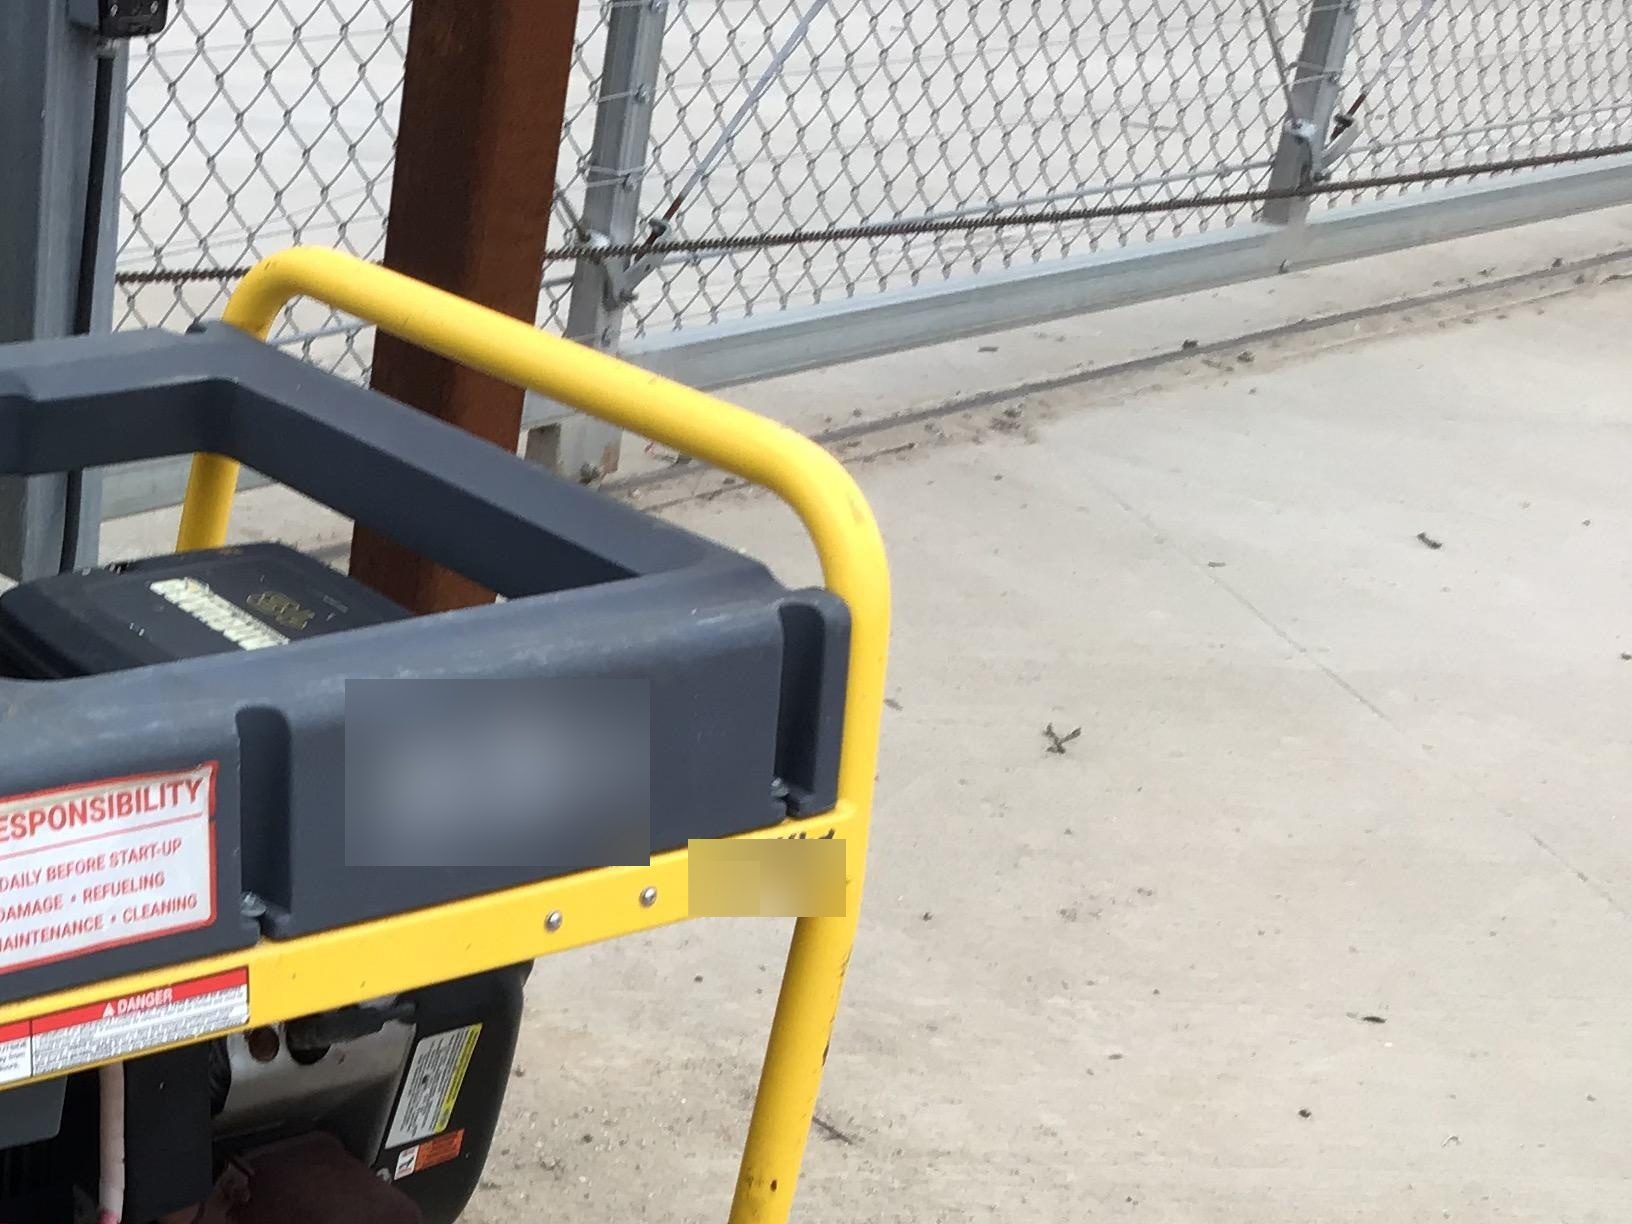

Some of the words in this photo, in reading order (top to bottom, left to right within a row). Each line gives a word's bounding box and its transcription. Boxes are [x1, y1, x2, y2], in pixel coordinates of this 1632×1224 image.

[45, 852, 106, 883] BEFORE
[109, 837, 183, 869] START-UP
[82, 870, 166, 905] REFUELING
[122, 892, 198, 925] CLEANING
[118, 987, 174, 1013] DANGER
